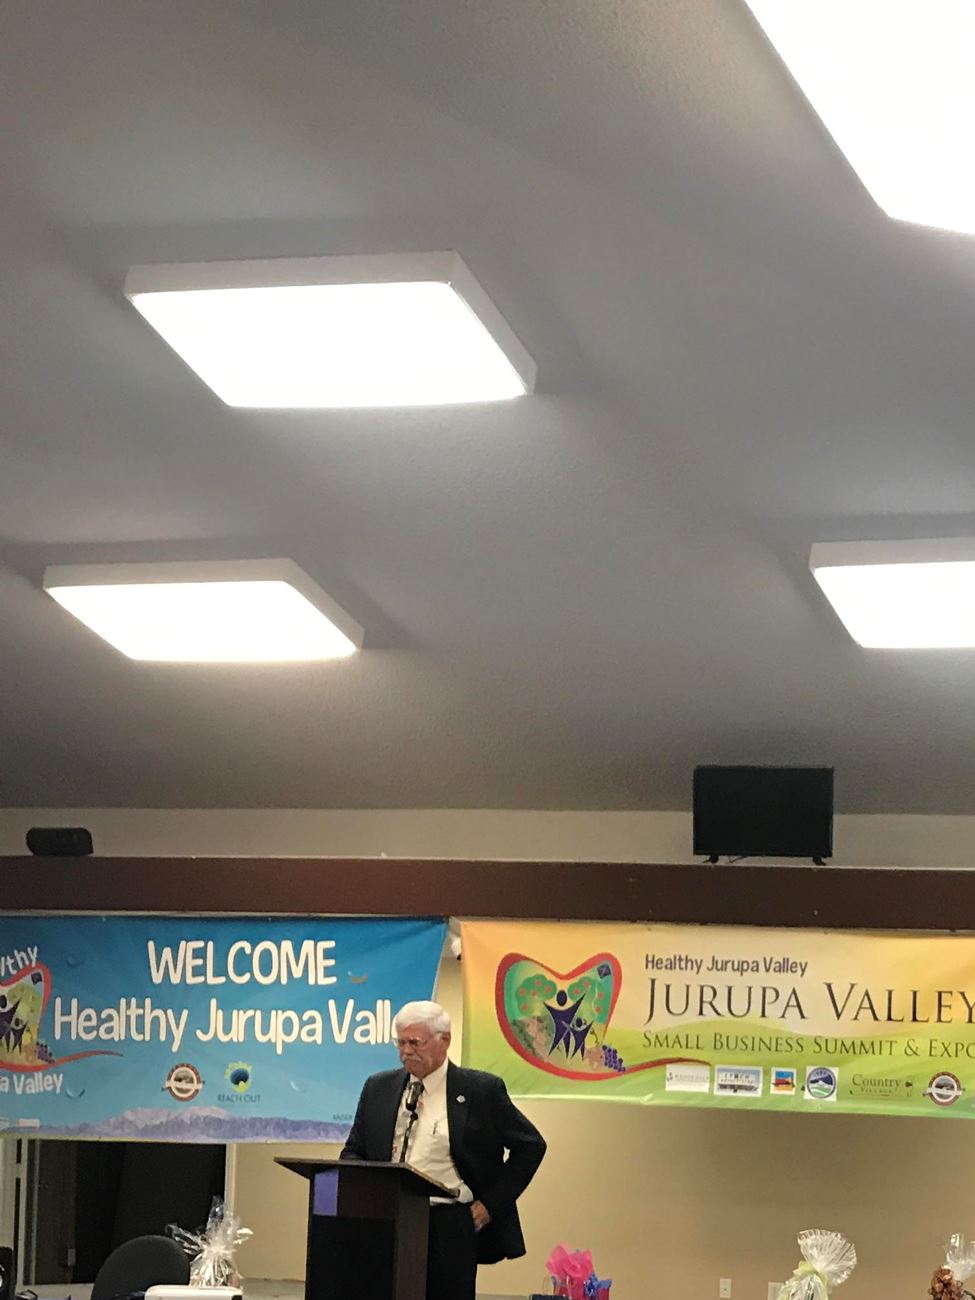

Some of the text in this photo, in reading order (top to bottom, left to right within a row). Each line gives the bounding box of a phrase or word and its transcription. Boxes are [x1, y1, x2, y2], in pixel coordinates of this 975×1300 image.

[0, 945, 39, 977] lthy
[147, 940, 337, 985] WELCOME
[645, 954, 808, 977] Healthy Jurupa Valley
[643, 977, 808, 1026] JURUPA
[54, 997, 397, 1055] Healthy Jurupa Vall
[643, 1030, 704, 1050] SMALL
[713, 1032, 804, 1053] BUSINESS
[813, 1035, 898, 1056] SUMMIT
[904, 1038, 920, 1057] &
[13, 1071, 63, 1095] Valley
[852, 1074, 901, 1090] Country
